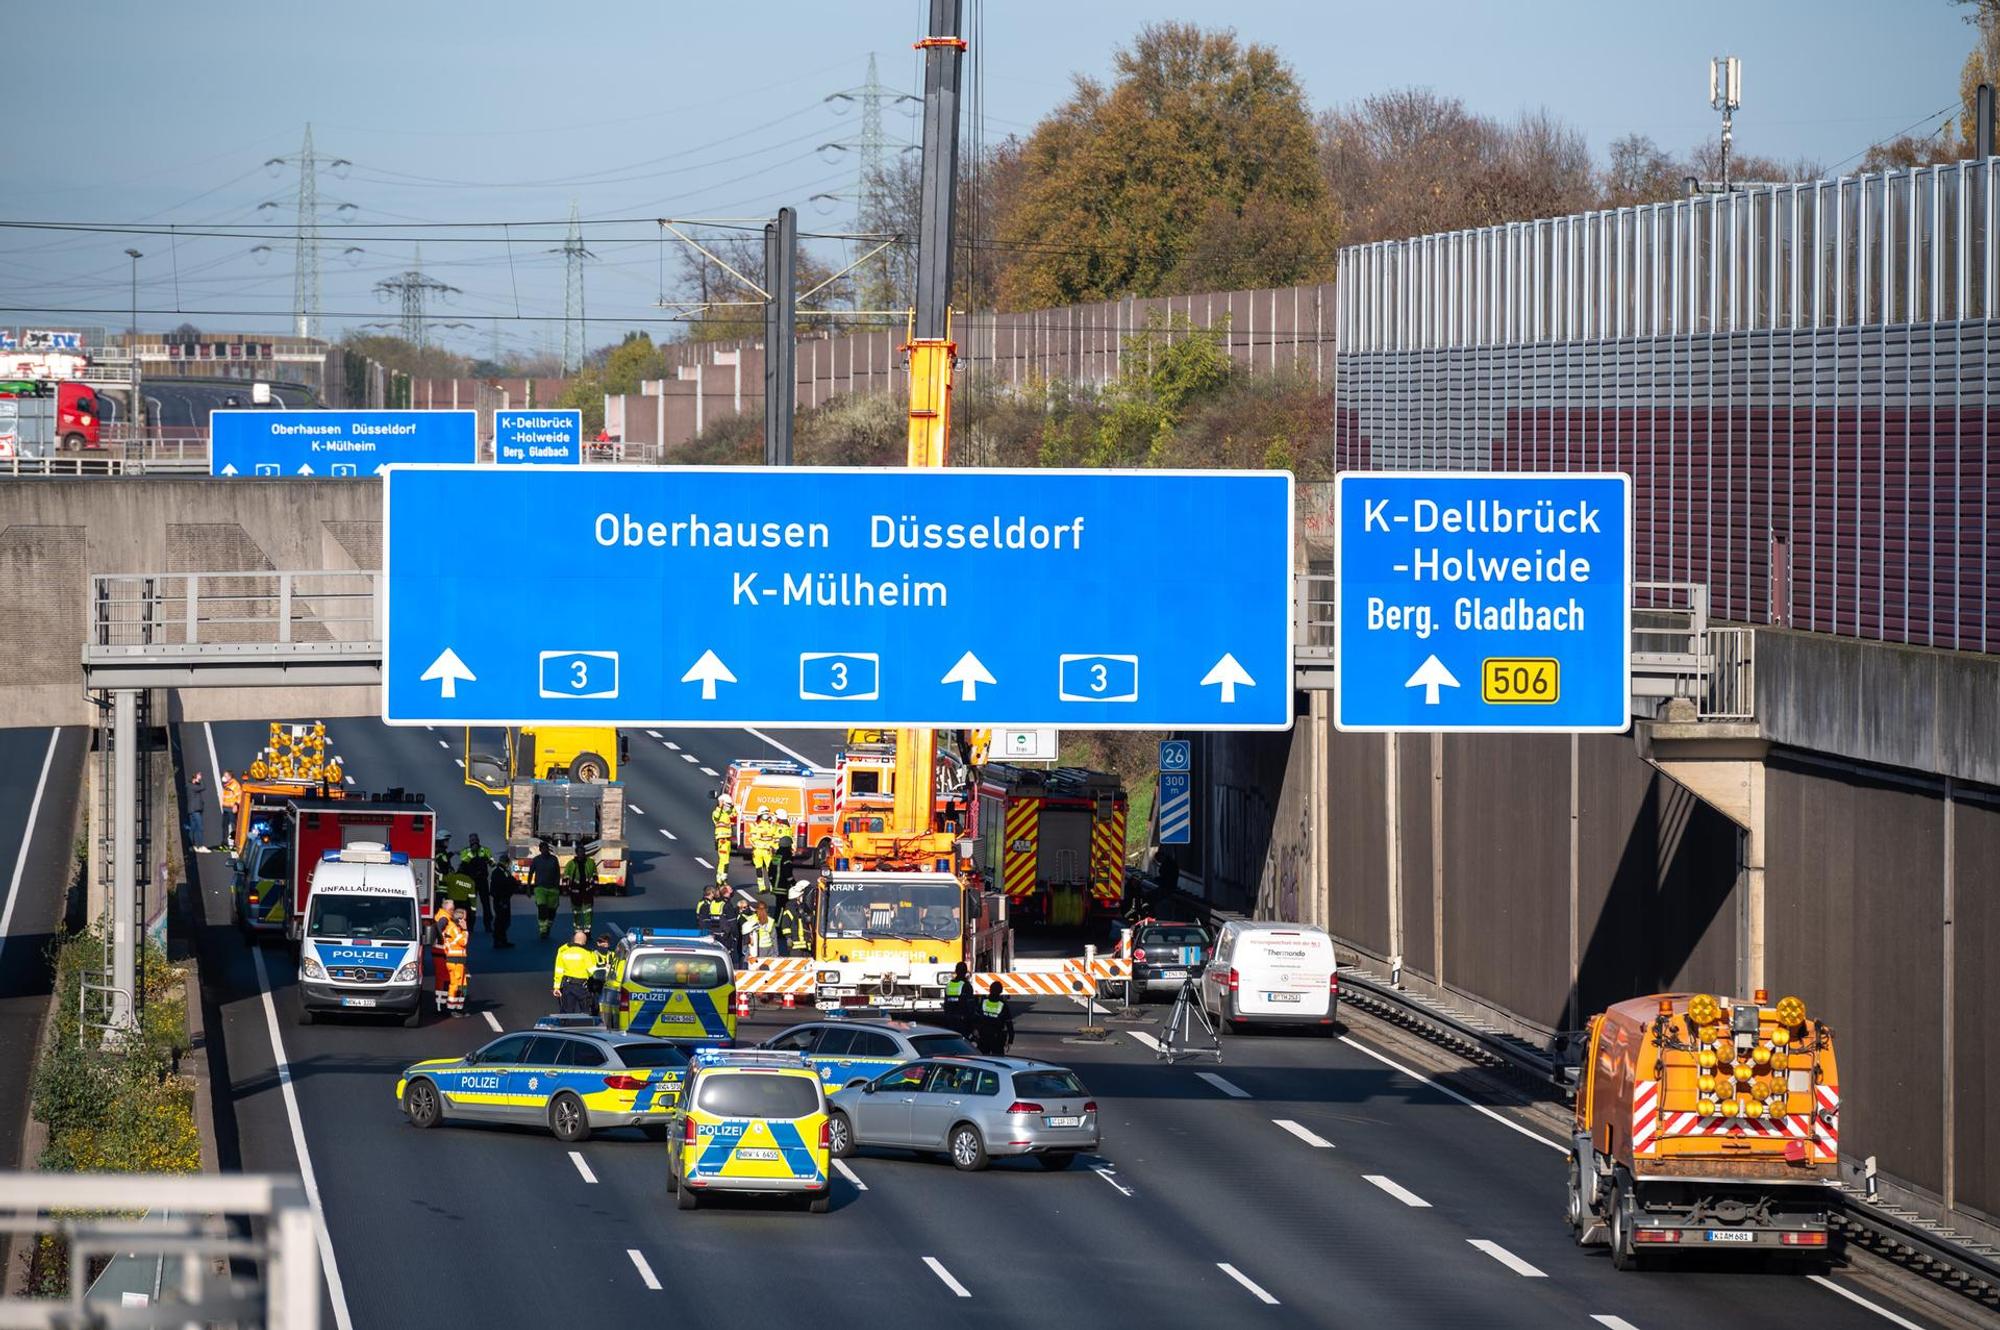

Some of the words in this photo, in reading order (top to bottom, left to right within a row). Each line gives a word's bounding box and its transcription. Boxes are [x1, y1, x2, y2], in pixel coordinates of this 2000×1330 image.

[271, 423, 342, 435] Oberhausen
[352, 423, 417, 435] Düsseldorf
[502, 417, 573, 429] K-Dellbrück
[511, 432, 570, 443] -Holweide
[311, 440, 376, 452] K-Mülheim
[503, 446, 525, 459] Berg.
[529, 446, 569, 457] Gladbach
[1363, 498, 1601, 534] K-Dellbrück
[594, 512, 829, 549] Oberhausen
[870, 514, 1086, 551] Düsseldorf
[1392, 548, 1592, 583] -Holweide
[733, 571, 949, 607] K-Mülheim
[1367, 597, 1440, 640] Berg.
[1454, 597, 1585, 633] Gladbach
[570, 660, 588, 689] 3
[830, 661, 848, 690] 3
[1090, 663, 1108, 693] 3
[1493, 667, 1549, 695] 506
[1165, 748, 1184, 763] 26
[1165, 776, 1185, 786] 300
[757, 795, 789, 804] NOTARZT
[320, 884, 408, 896] UNFALLAUFNAHME
[829, 883, 855, 892] KRAN
[857, 883, 864, 891] 2
[332, 950, 389, 960] POLIZEI
[851, 950, 927, 960] FEUERWEHR
[631, 992, 666, 1001] POLIZEI
[461, 1076, 499, 1089] POLIZEI
[698, 1125, 743, 1136] POLIZEI
